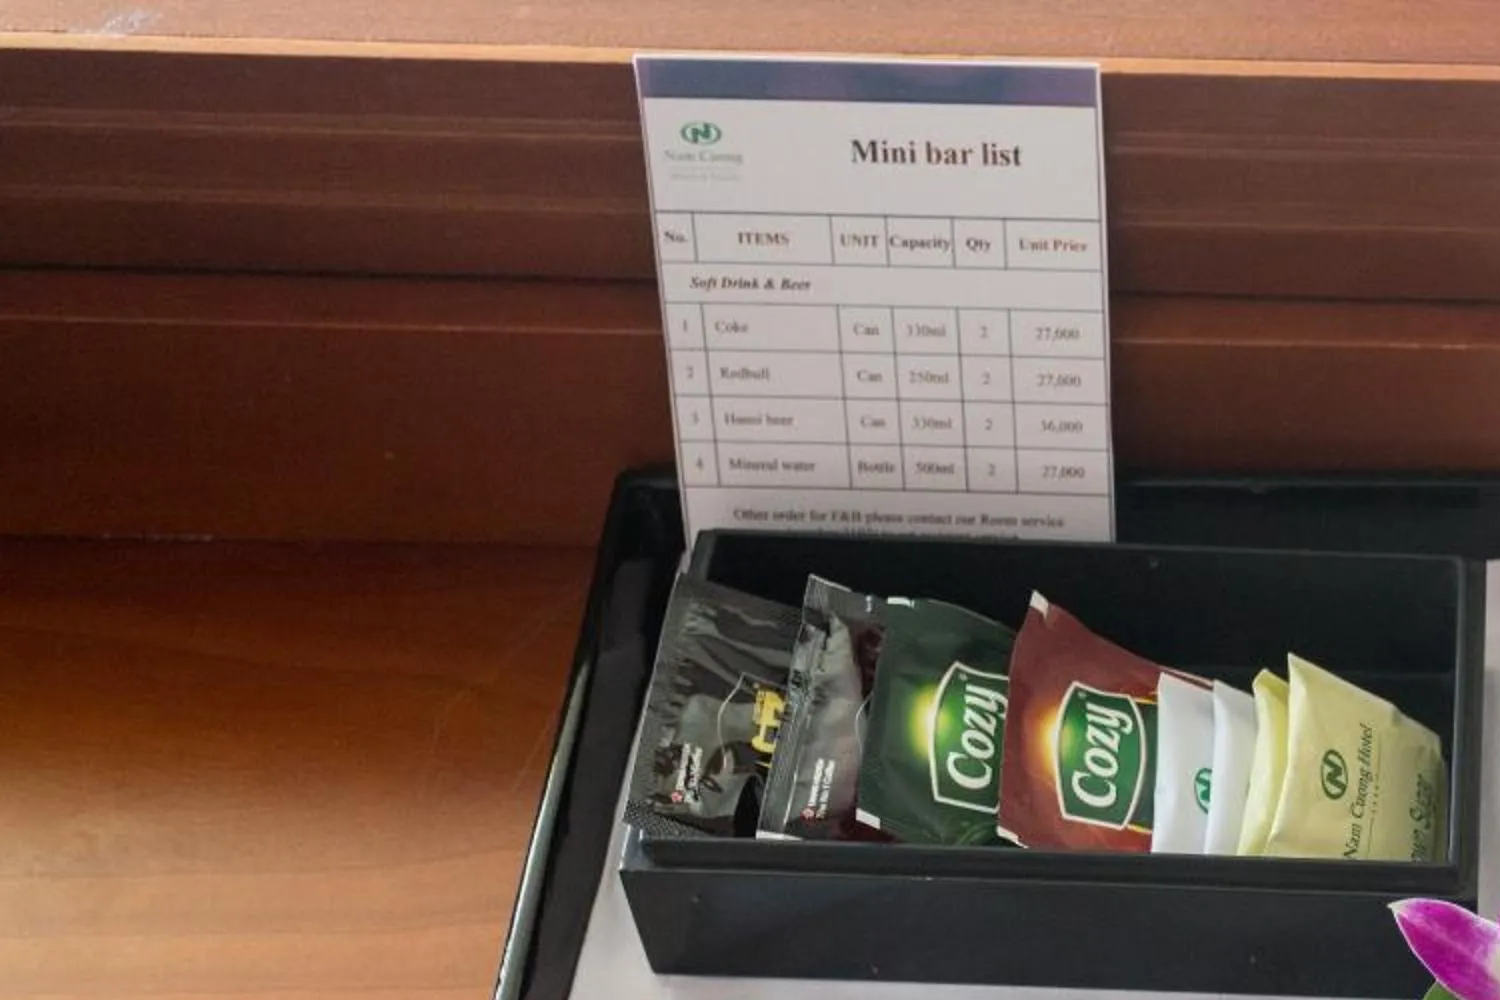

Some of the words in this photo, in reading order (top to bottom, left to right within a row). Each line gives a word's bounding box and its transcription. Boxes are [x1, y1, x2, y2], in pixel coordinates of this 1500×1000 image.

[850, 139, 917, 164] Mini
[925, 141, 974, 165] bar
[981, 142, 1021, 166] list
[737, 231, 790, 245] ITEMS
[840, 233, 879, 248] UNIT
[889, 234, 950, 252] Capacity
[966, 237, 991, 252] Qty
[1019, 239, 1050, 250] Unit
[1053, 239, 1088, 252] Price
[689, 276, 717, 290] Soft
[721, 276, 759, 290] Drink
[763, 278, 775, 290] &
[780, 279, 811, 291] Beer
[715, 318, 749, 333] Coke
[853, 322, 880, 336] Can
[979, 325, 988, 338] 2
[720, 366, 770, 380] Redbull
[857, 370, 883, 383] Can
[982, 371, 991, 385] 2
[860, 415, 886, 428] Can
[984, 418, 993, 431] 2
[729, 458, 778, 471] Mineral
[782, 460, 816, 472] water
[947, 683, 1009, 789] Cozy
[1072, 702, 1133, 808] Cozy
[1351, 767, 1373, 819] Cuong
